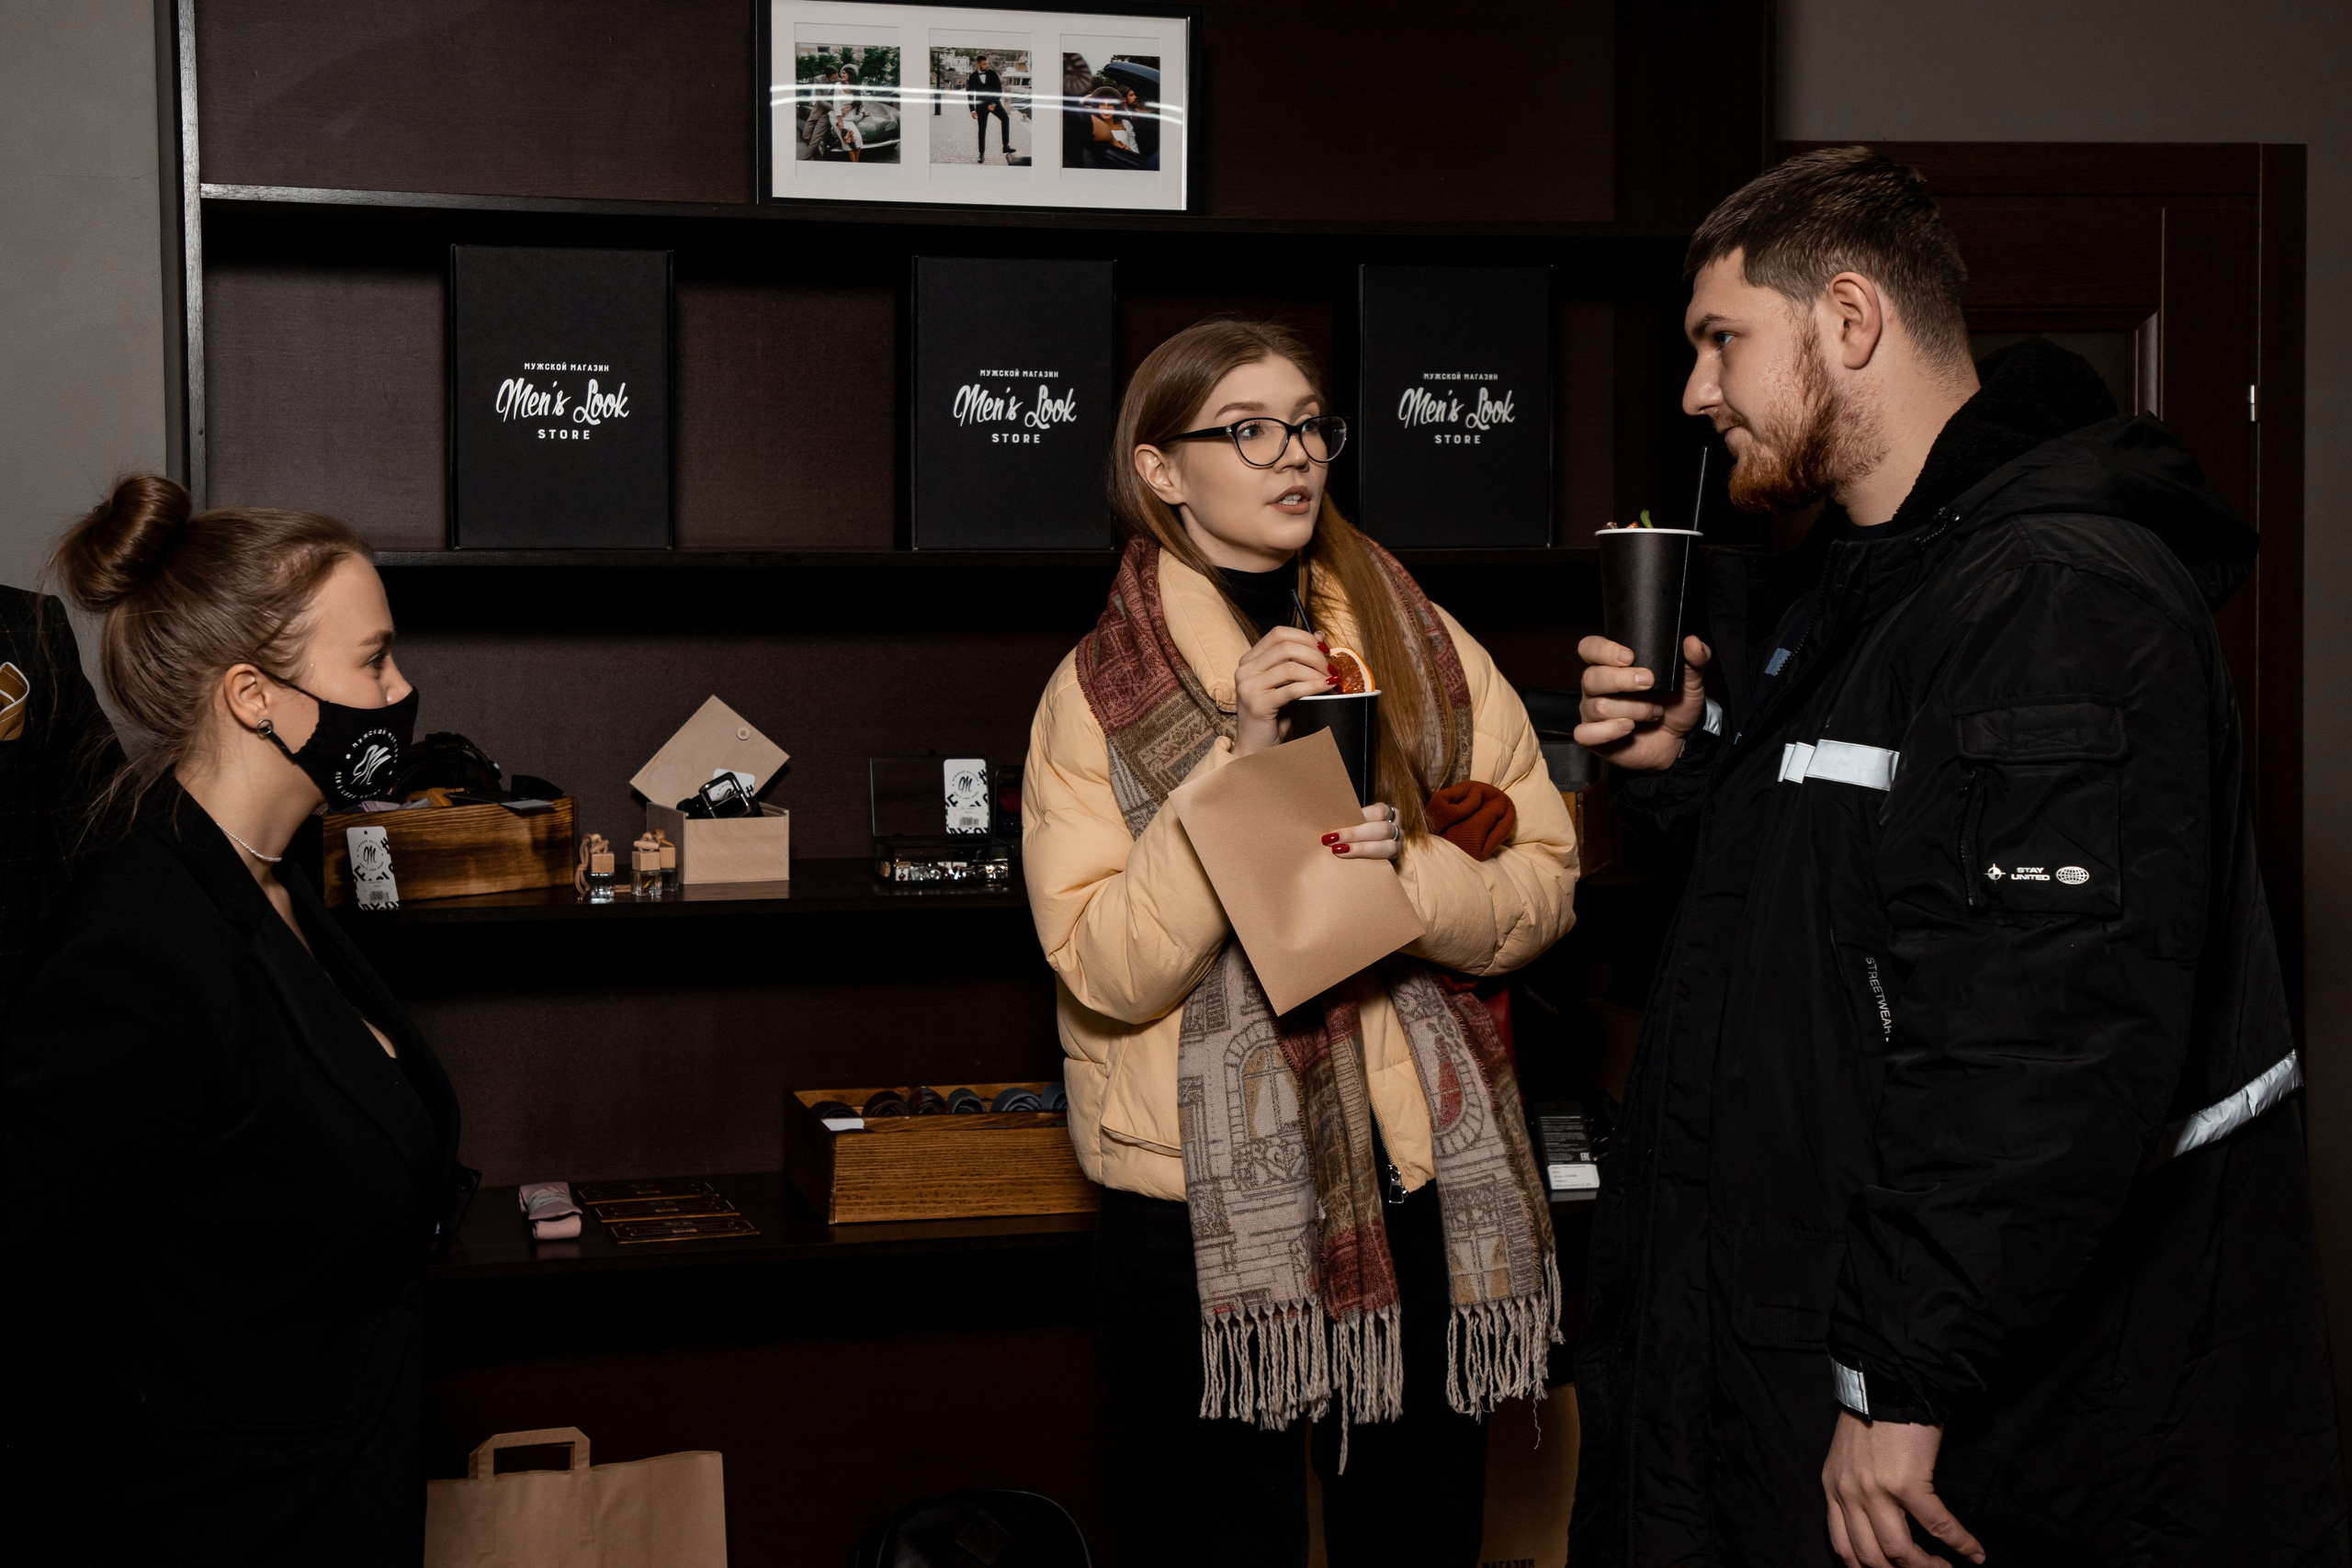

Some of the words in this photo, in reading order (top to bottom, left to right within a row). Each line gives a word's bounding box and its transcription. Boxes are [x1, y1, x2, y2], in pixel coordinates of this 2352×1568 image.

[524, 361, 567, 371] МУЖСКОЙ
[570, 364, 609, 372] МАГАЗИН
[979, 368, 1020, 378] МУЖСКОЙ
[1022, 370, 1059, 378] МАГАЗИН
[1423, 371, 1462, 380] МУЖСКОЙ
[495, 377, 571, 423] Men's
[572, 378, 630, 426] Look
[953, 383, 1023, 427] Men's
[1023, 384, 1078, 430] Look
[1397, 387, 1464, 429] Men's
[1464, 387, 1516, 431] Look
[537, 428, 591, 440] STORE
[991, 433, 1041, 444] STORE
[1434, 434, 1481, 445] STORE
